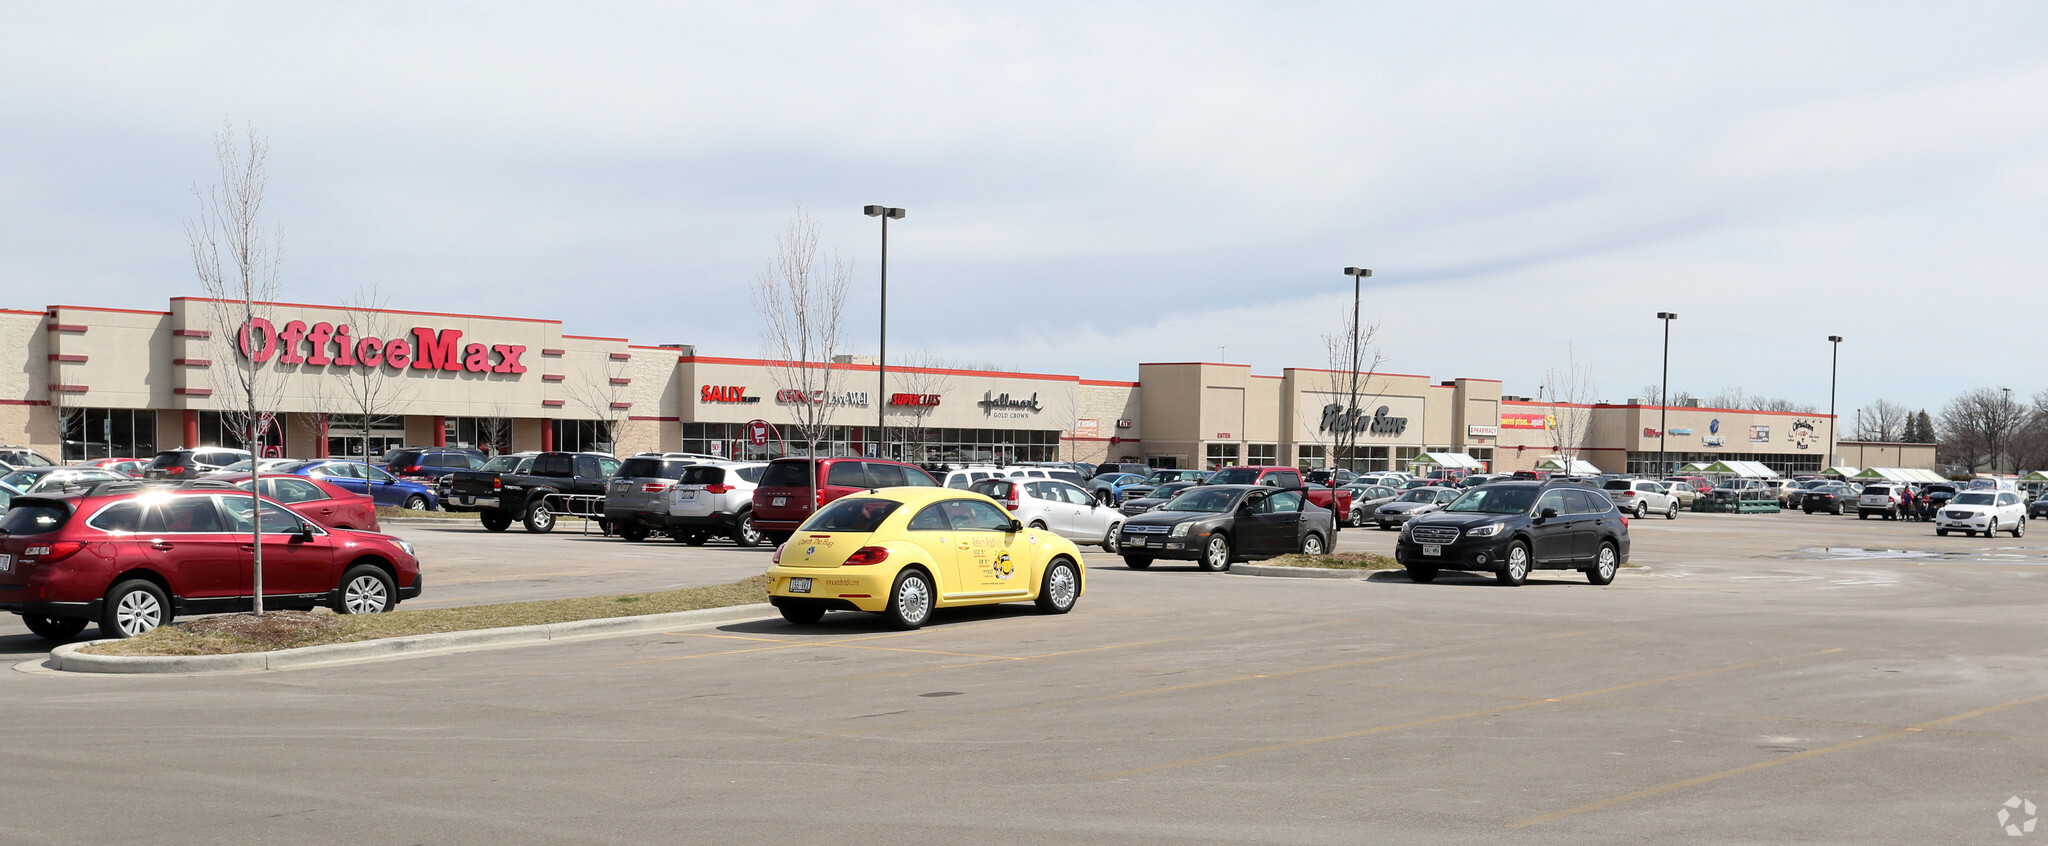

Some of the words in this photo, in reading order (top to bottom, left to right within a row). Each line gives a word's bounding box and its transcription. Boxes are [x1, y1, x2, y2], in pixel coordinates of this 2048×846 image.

[239, 317, 527, 374] OfficeMax
[701, 385, 746, 402] SALLY
[777, 389, 824, 403] GNC
[891, 393, 941, 406] SUPERCUTS
[978, 389, 1044, 420] Hallmark
[1371, 405, 1408, 434] Save
[823, 539, 834, 548] Bug
